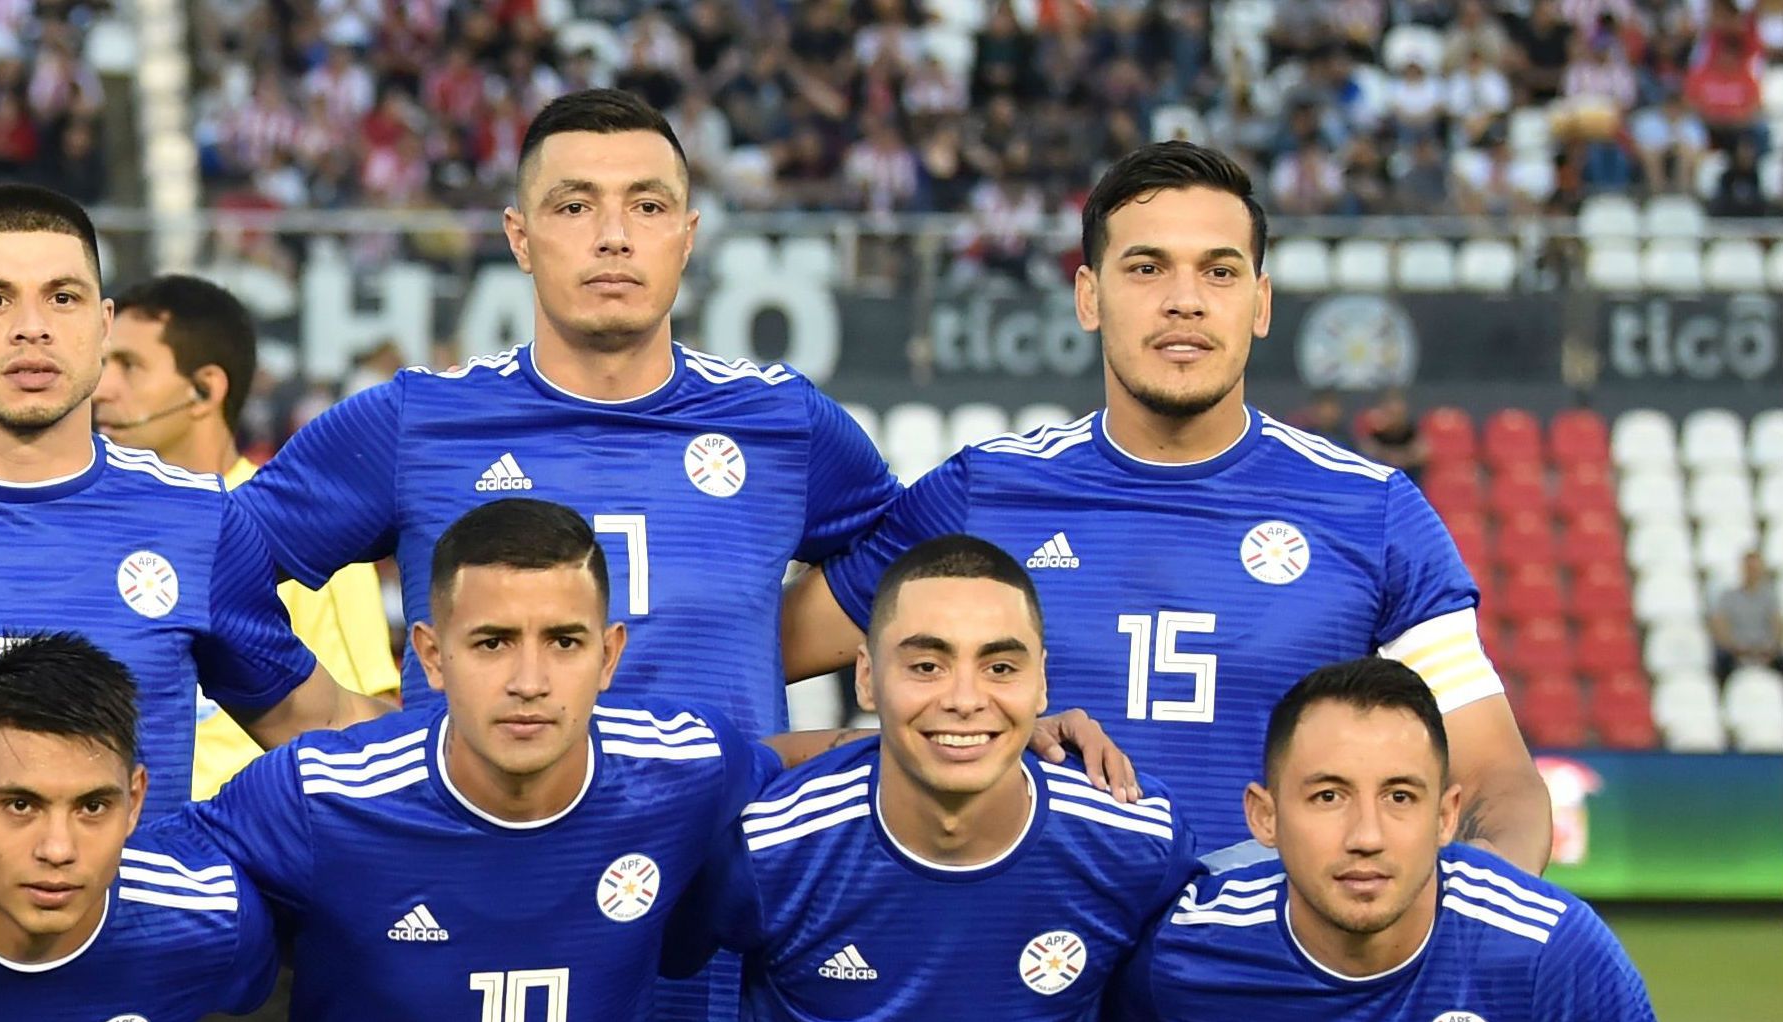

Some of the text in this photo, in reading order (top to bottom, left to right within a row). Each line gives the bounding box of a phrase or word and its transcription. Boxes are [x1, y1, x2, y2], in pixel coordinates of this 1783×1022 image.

[704, 437, 726, 449] APF
[475, 476, 533, 491] adidas
[1266, 526, 1290, 538] APF
[138, 556, 158, 567] APF
[593, 514, 649, 616] 7
[1026, 555, 1080, 569] adidas
[1117, 610, 1217, 723] 15
[619, 858, 641, 871] APF
[387, 927, 449, 942] adidas
[1044, 935, 1068, 946] APF
[818, 966, 878, 980] adidas
